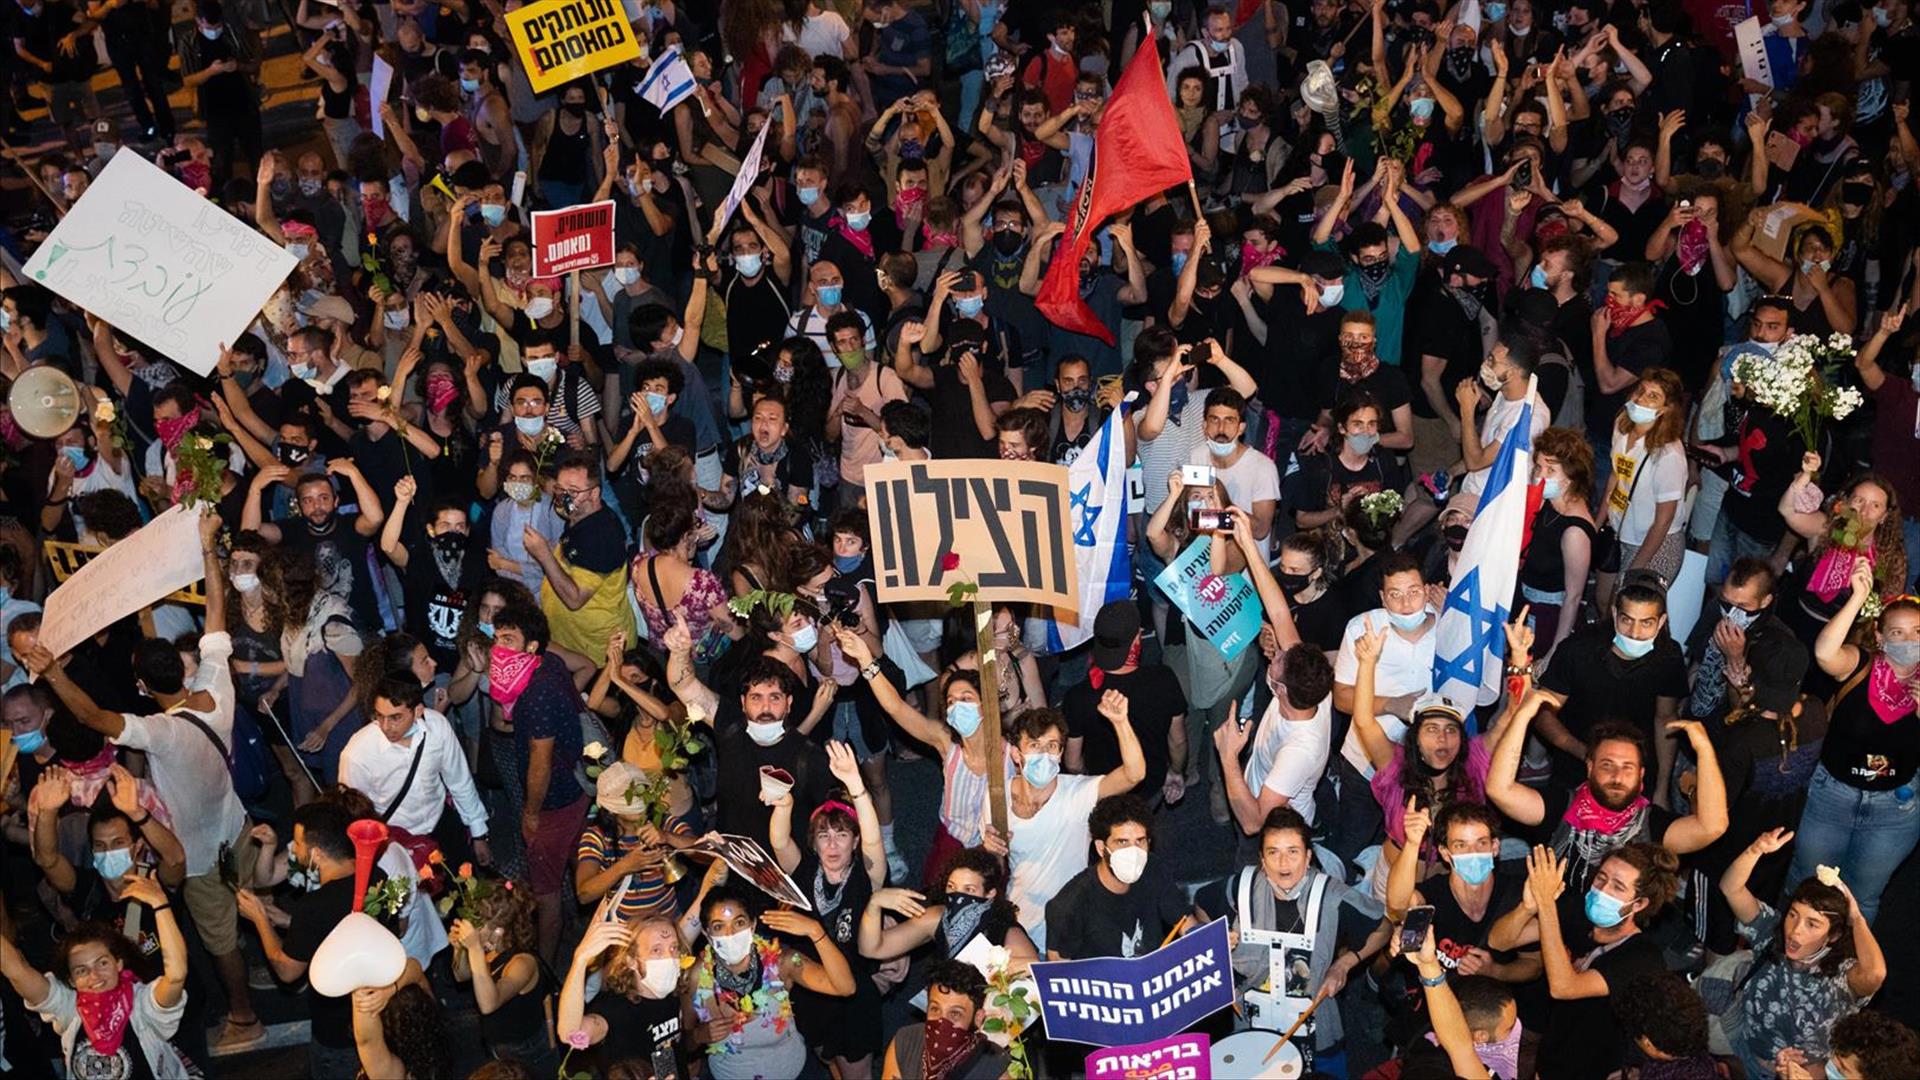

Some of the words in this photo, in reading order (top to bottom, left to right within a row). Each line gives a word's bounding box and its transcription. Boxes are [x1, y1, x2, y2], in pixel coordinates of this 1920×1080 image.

[522, 0, 616, 45] מנותקים
[529, 21, 626, 77] נמאסתם!
[544, 233, 591, 263] נמאסתם.
[875, 464, 1068, 596] הצילו!
[1183, 543, 1211, 578] וצרים
[1200, 577, 1224, 600] נגיף
[1204, 584, 1253, 637] הדיקטטורה
[1049, 978, 1134, 1001] ההווה
[1142, 948, 1216, 998] אנחנו
[1048, 1001, 1144, 1025] העתיד
[1151, 970, 1223, 1020] אנחנו
[1095, 1042, 1201, 1075] בריאות
